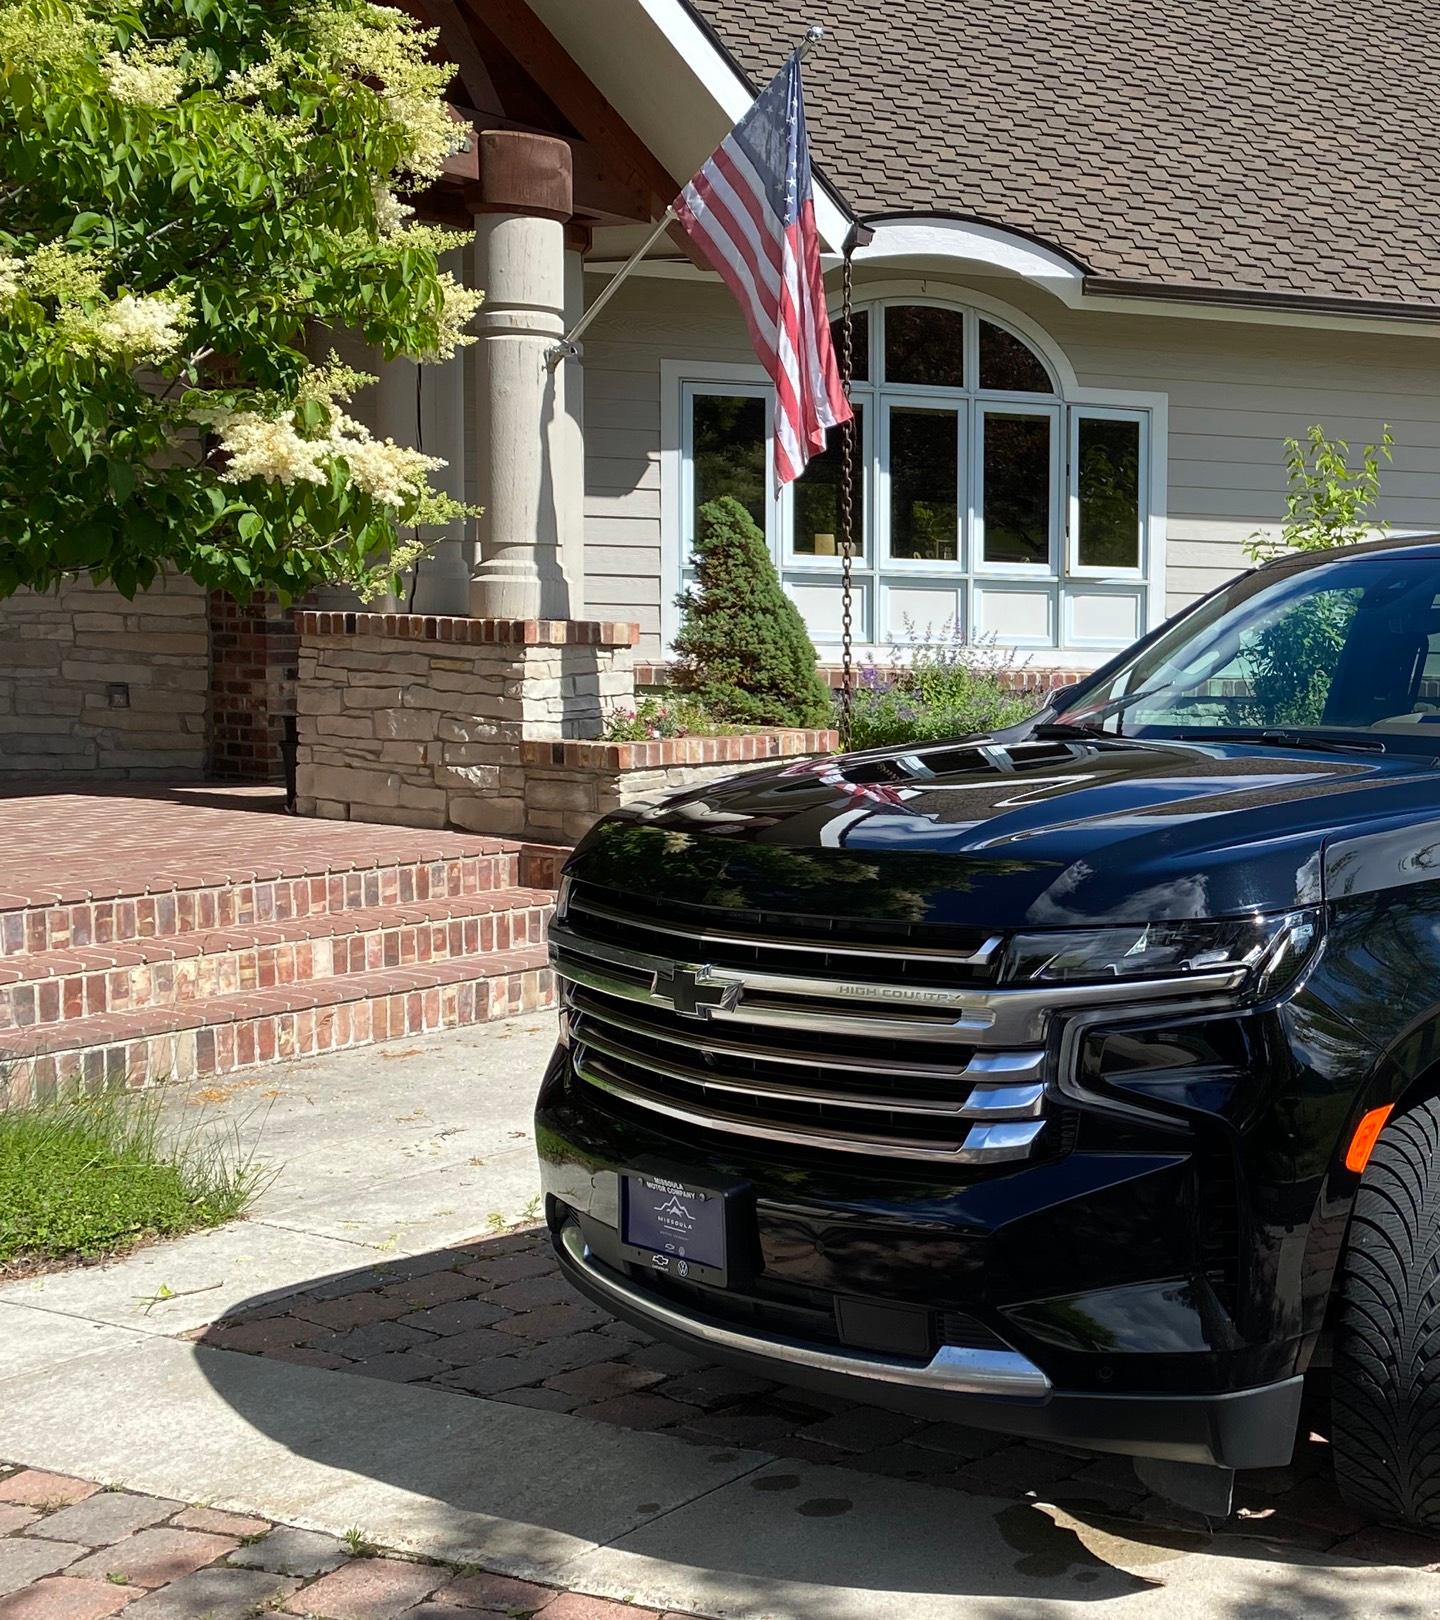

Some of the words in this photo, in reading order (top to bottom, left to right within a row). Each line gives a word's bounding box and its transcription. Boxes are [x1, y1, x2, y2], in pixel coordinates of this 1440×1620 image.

[839, 985, 877, 997] HIGH
[882, 989, 961, 1002] COUNTRY
[657, 1215, 693, 1230] MISSOULA
